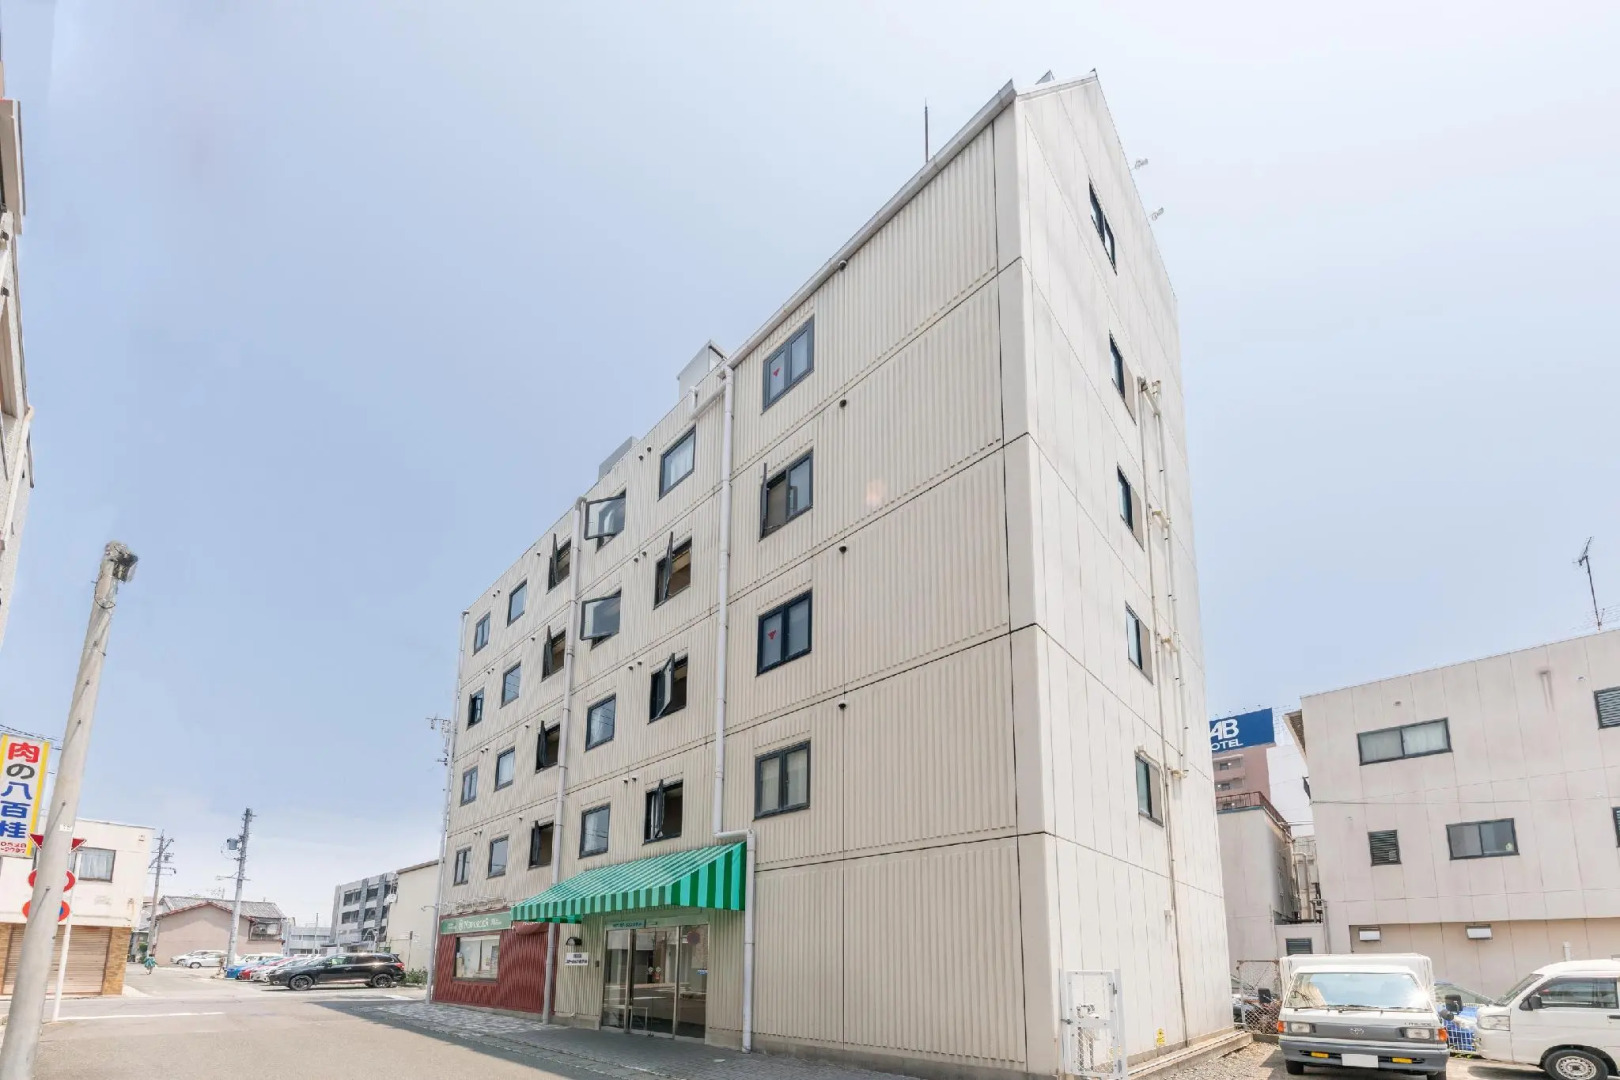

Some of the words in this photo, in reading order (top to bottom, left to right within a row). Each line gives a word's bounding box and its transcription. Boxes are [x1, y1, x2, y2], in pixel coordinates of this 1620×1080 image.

[1210, 718, 1240, 741] AB
[0, 742, 40, 839] 肉の八百桂
